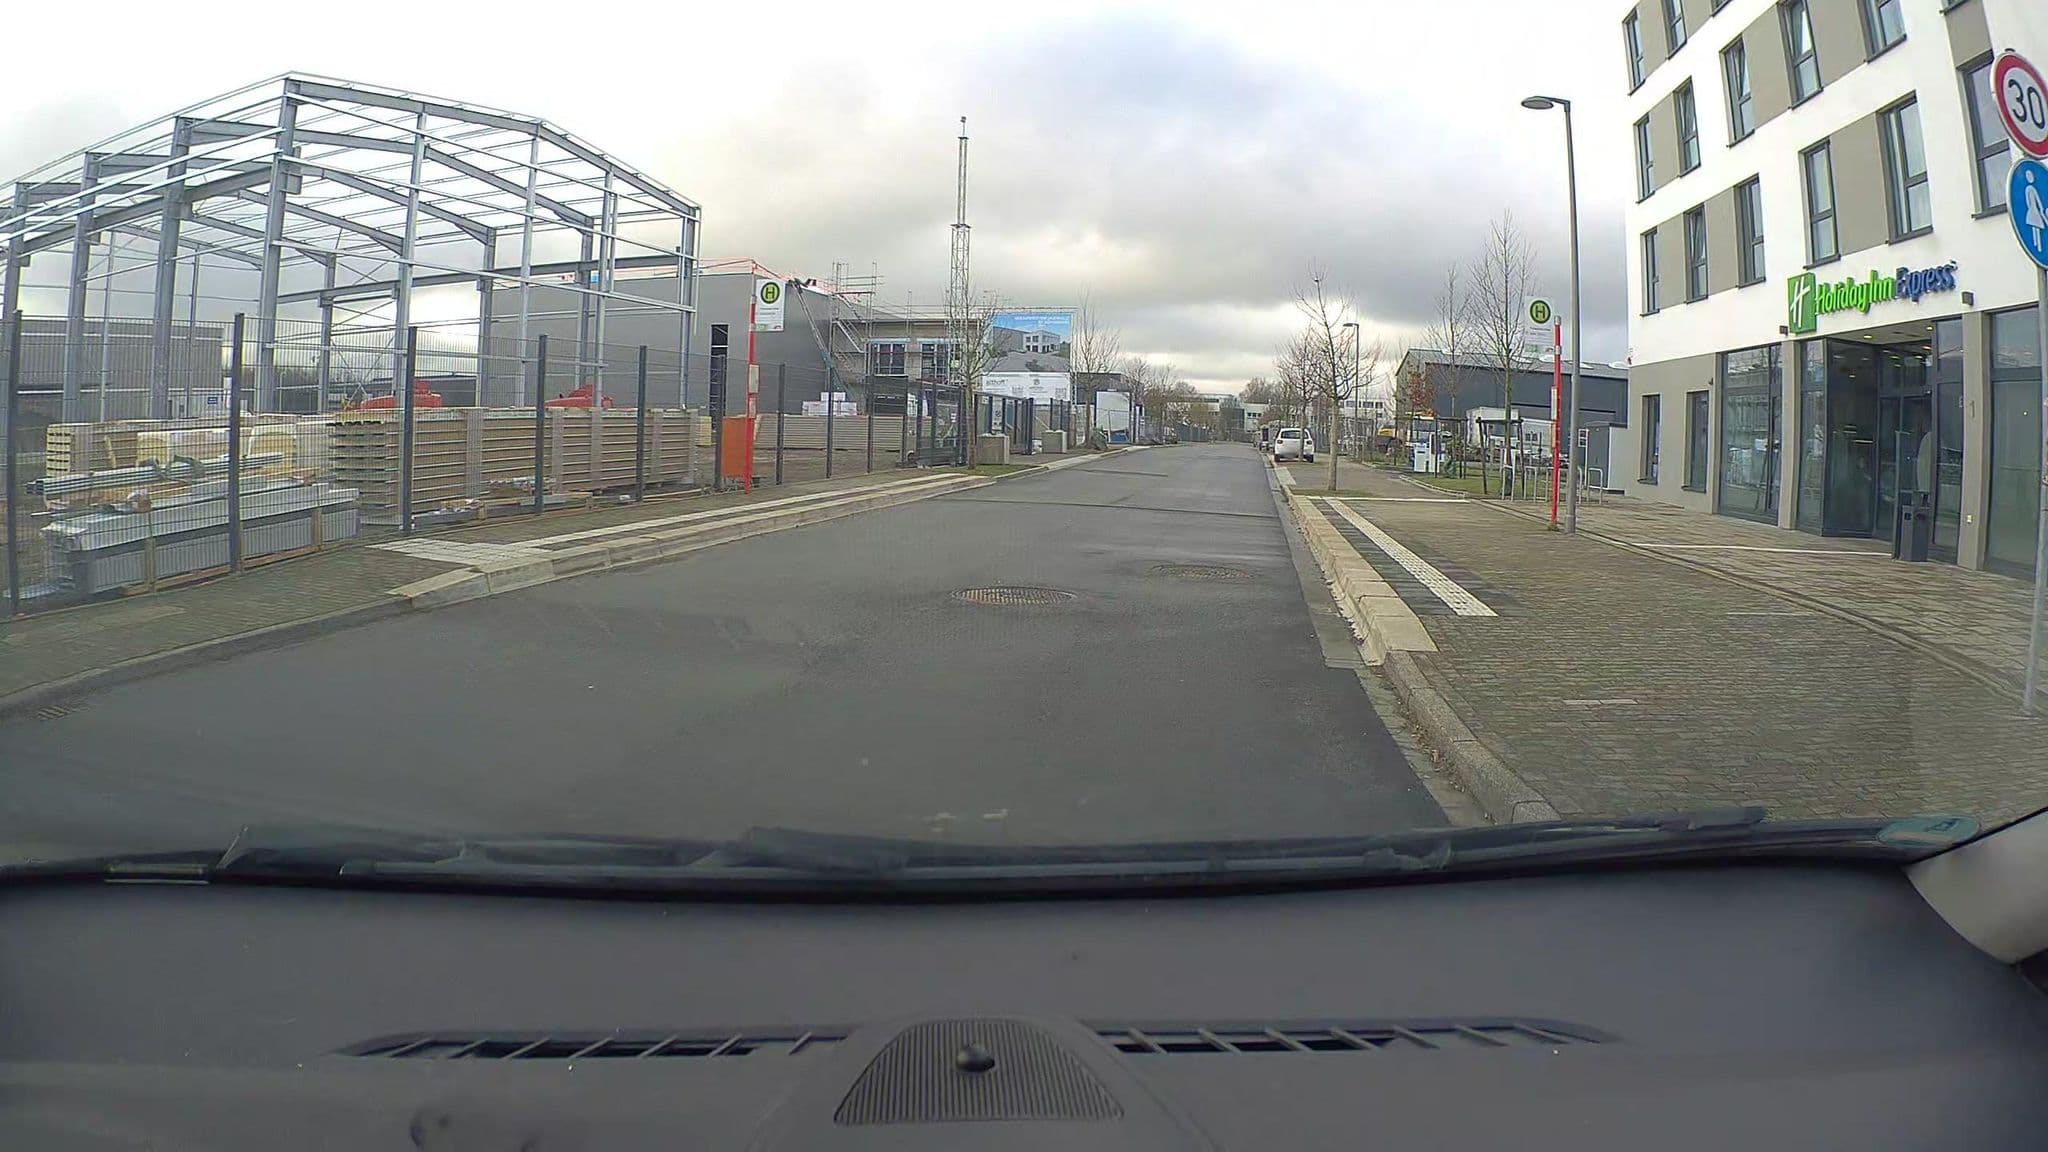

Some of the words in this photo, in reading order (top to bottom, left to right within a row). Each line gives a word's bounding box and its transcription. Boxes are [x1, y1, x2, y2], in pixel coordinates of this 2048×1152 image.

[2008, 79, 2046, 130] 30
[765, 287, 775, 299] H
[1815, 277, 1869, 315] Holiday
[1869, 269, 1896, 304] Inn
[1896, 263, 1956, 302] Express
[1535, 305, 1545, 319] H
